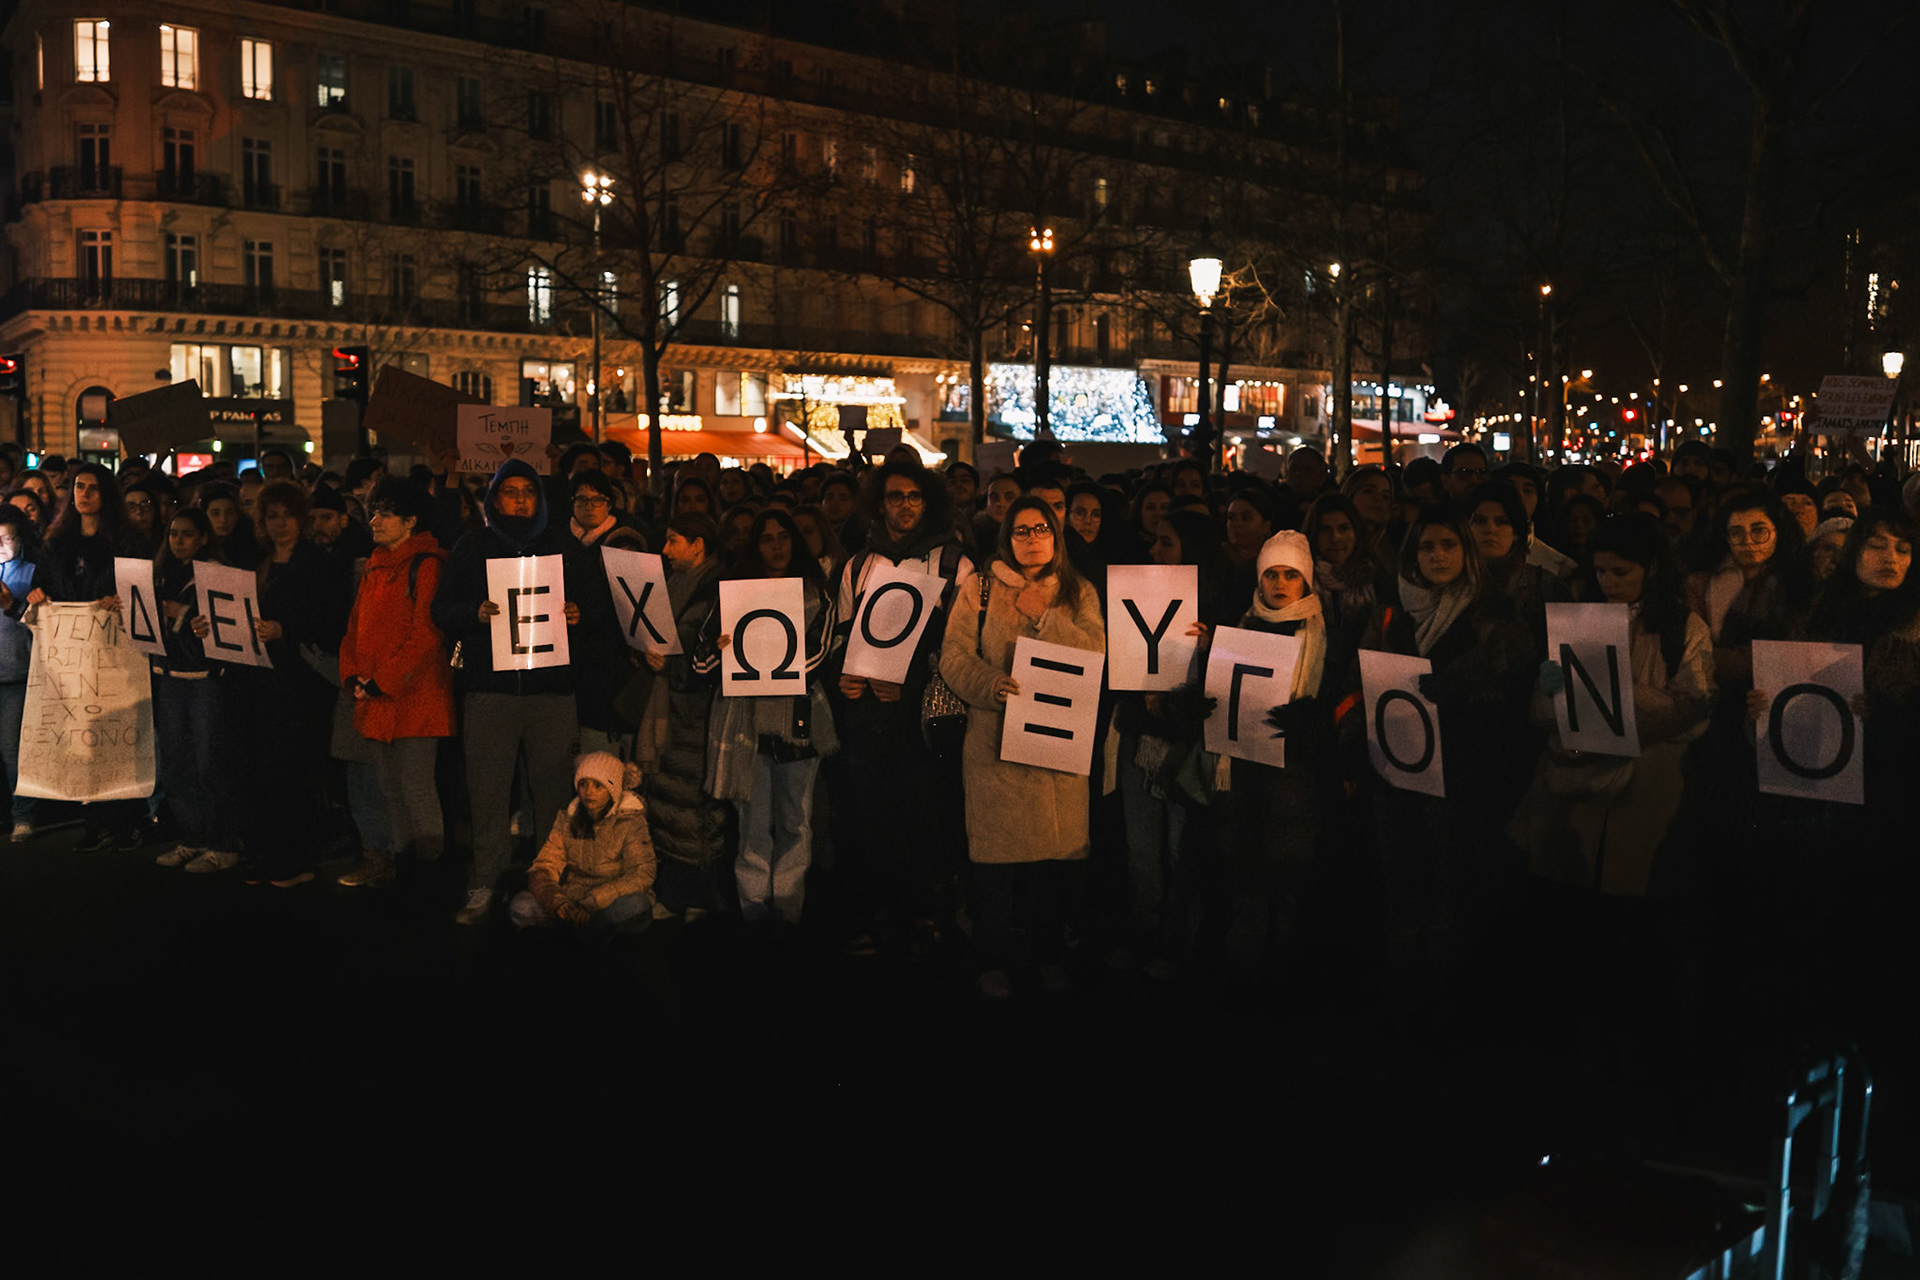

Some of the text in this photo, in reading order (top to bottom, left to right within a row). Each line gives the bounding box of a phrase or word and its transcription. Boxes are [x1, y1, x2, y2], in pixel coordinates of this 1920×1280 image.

[478, 412, 529, 435] ΤΕΜΠΗ
[131, 585, 157, 644] Δ
[508, 586, 554, 655] Ε
[616, 575, 667, 645] Χ
[732, 609, 799, 681] Ω
[861, 582, 923, 649] Ο
[1122, 599, 1182, 674] Υ
[1024, 657, 1084, 740] Ξ
[1228, 663, 1274, 741] Γ
[1559, 643, 1625, 737] Ν
[1375, 689, 1435, 773] Ο
[1768, 683, 1855, 780] Ο
